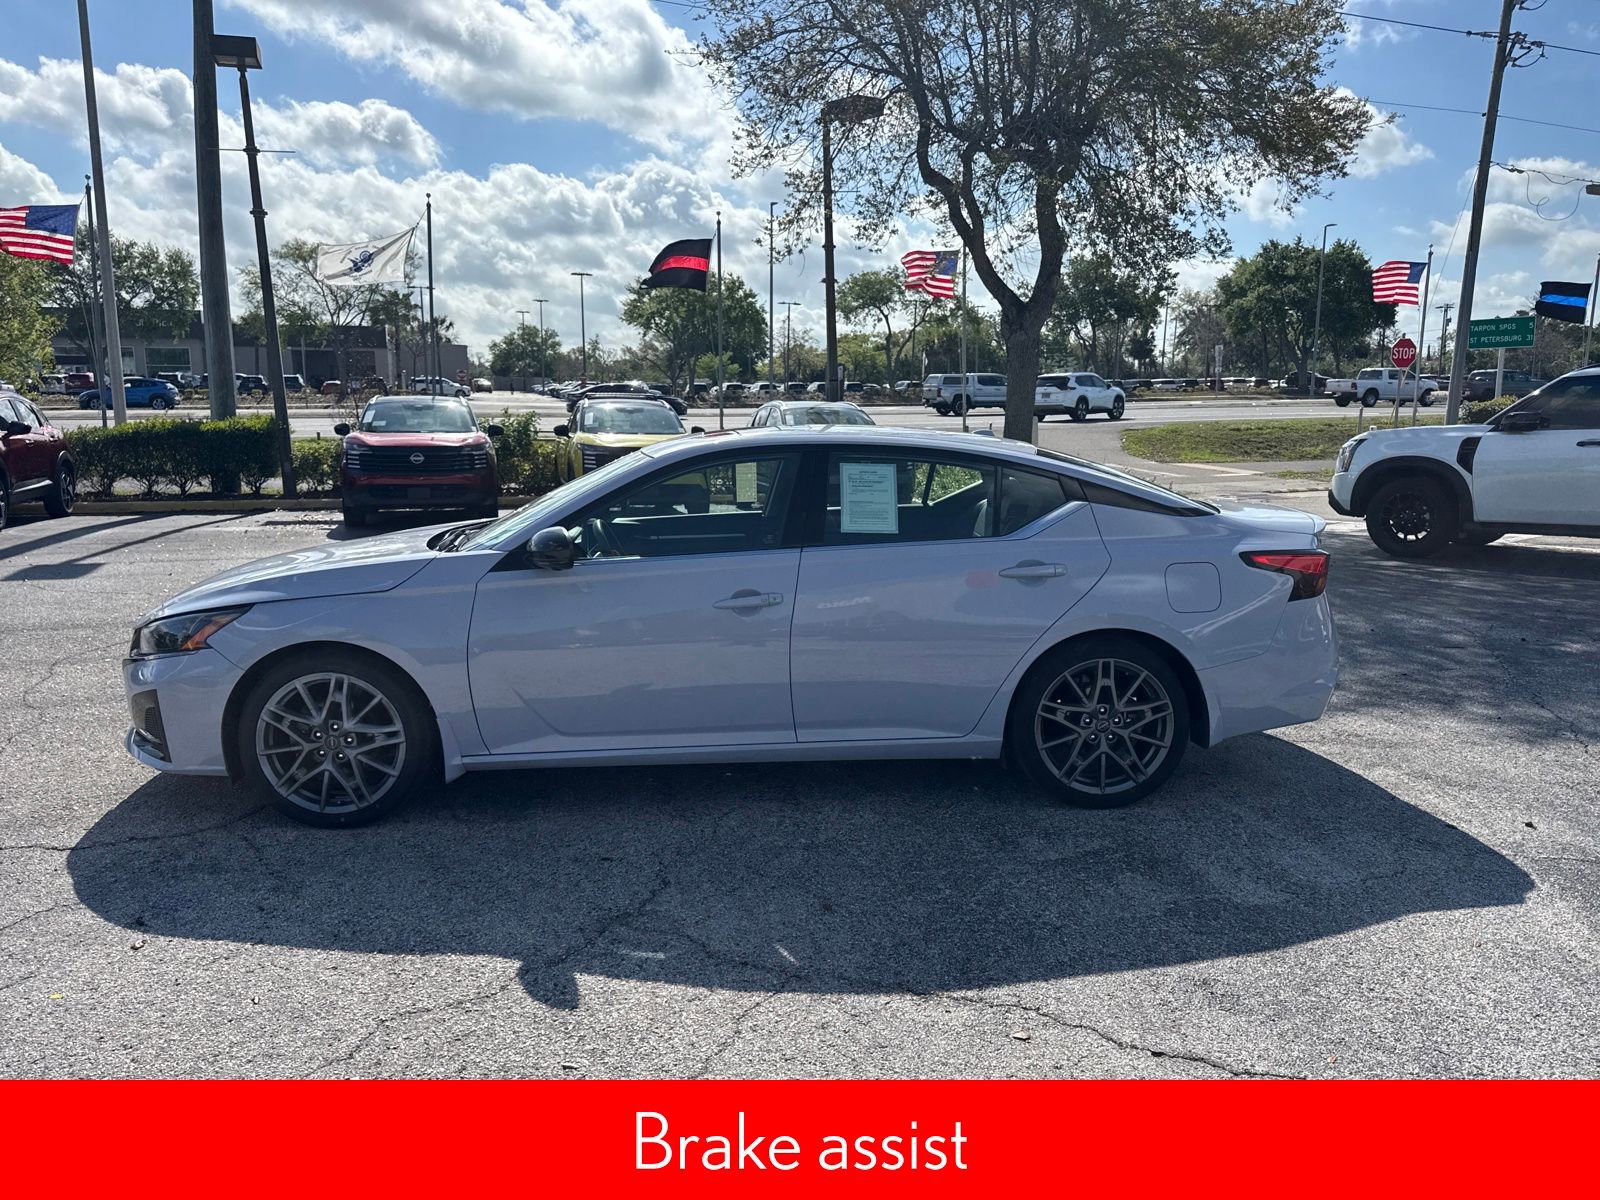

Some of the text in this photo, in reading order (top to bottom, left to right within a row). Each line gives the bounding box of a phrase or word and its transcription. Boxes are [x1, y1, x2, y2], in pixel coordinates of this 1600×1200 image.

[1470, 324, 1496, 332] TARPON
[1528, 321, 1534, 329] 5
[1480, 334, 1522, 343] PETERSBURG
[1392, 347, 1415, 359] STOP
